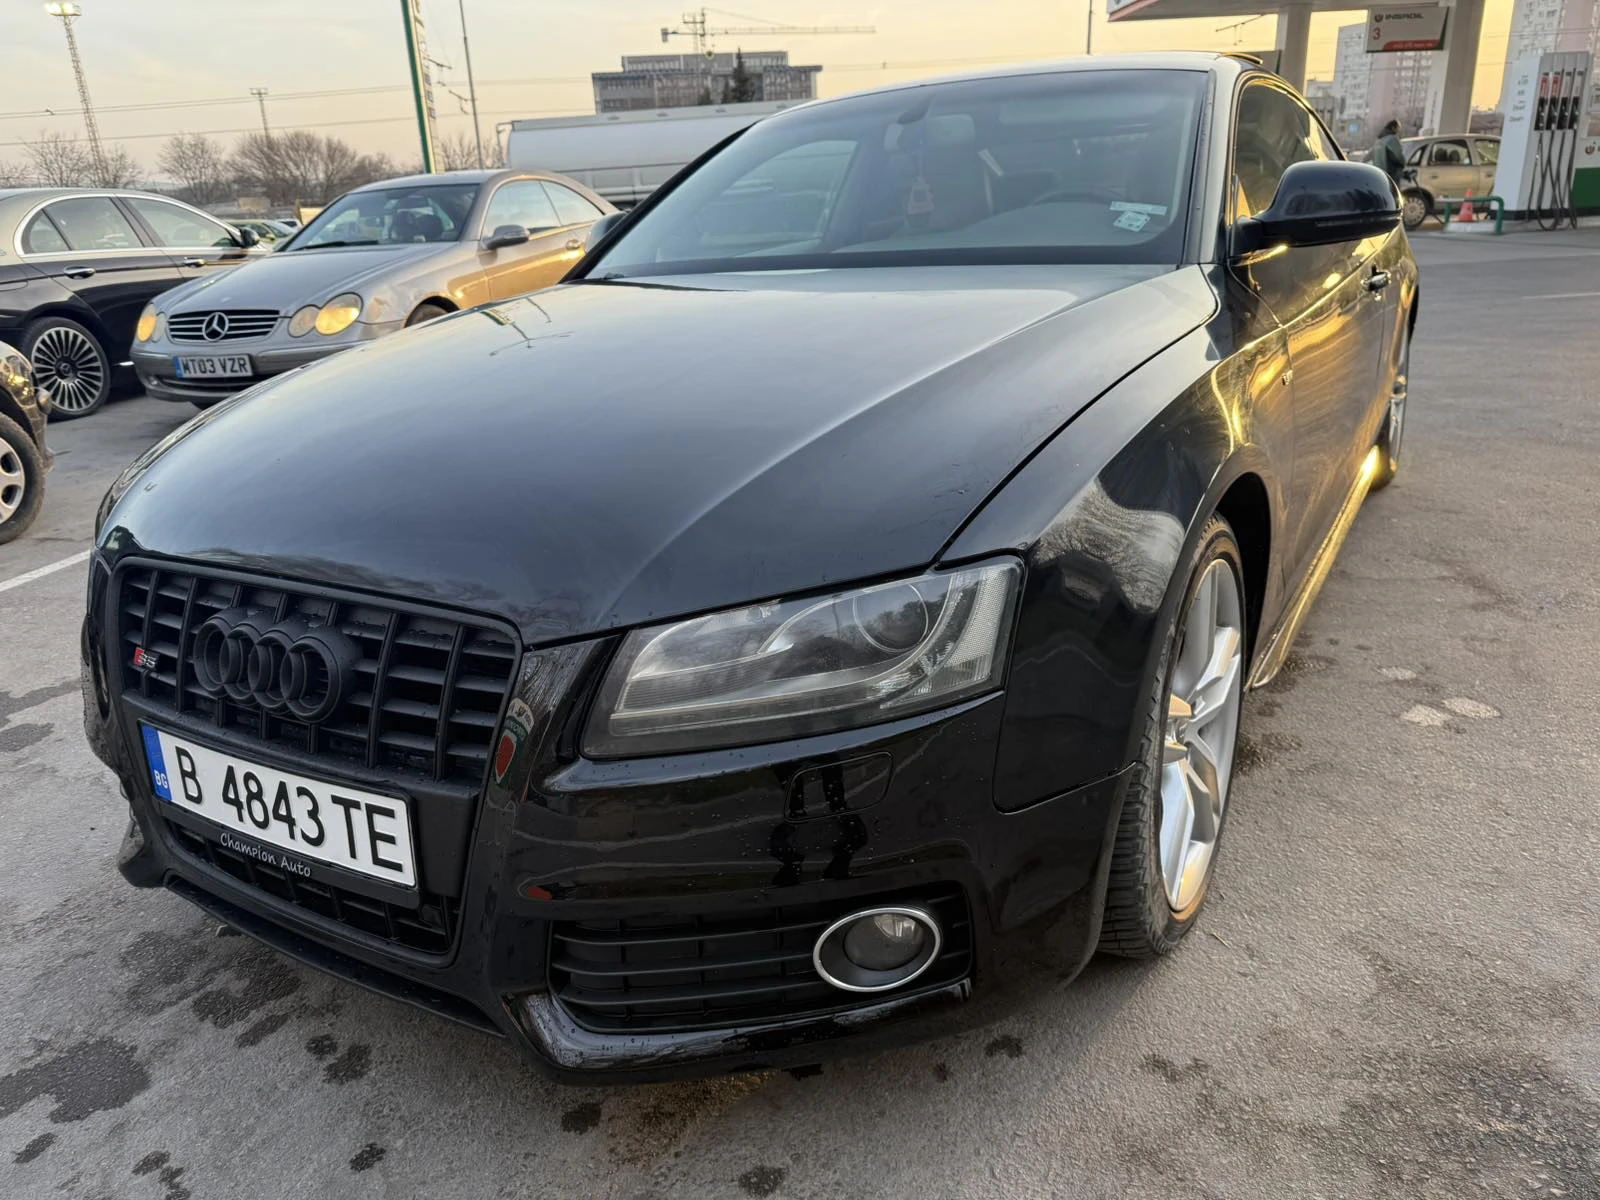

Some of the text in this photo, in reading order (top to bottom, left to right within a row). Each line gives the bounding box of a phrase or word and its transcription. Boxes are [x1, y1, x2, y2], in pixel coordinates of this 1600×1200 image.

[1372, 27, 1381, 40] 3
[218, 357, 248, 373] VZR
[153, 769, 169, 788] BG
[175, 745, 403, 873] B 4843 TE
[220, 832, 312, 878] Champion Auto
